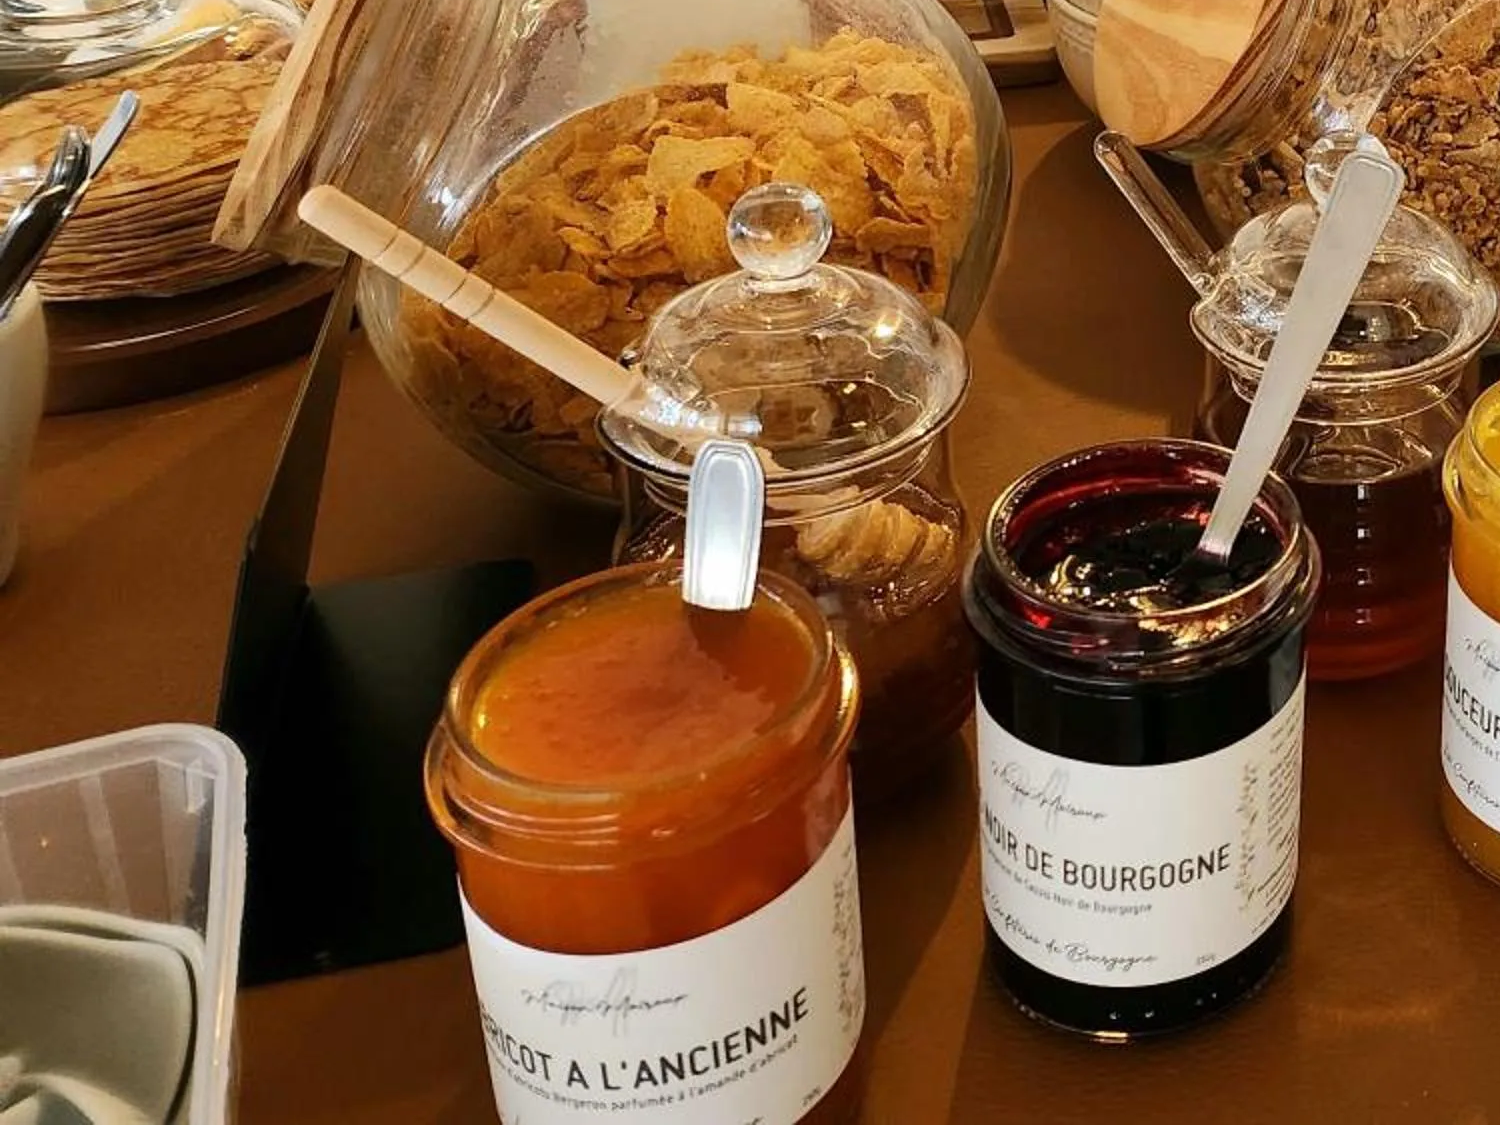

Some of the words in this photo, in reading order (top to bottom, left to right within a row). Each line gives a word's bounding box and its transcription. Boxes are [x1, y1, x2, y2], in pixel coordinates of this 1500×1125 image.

[985, 803, 1018, 862] NOIR
[1025, 842, 1054, 880] DE
[1063, 842, 1232, 892] BOURGOGNE
[567, 1059, 590, 1090] A
[601, 986, 809, 1091] L'ANCIENNE
